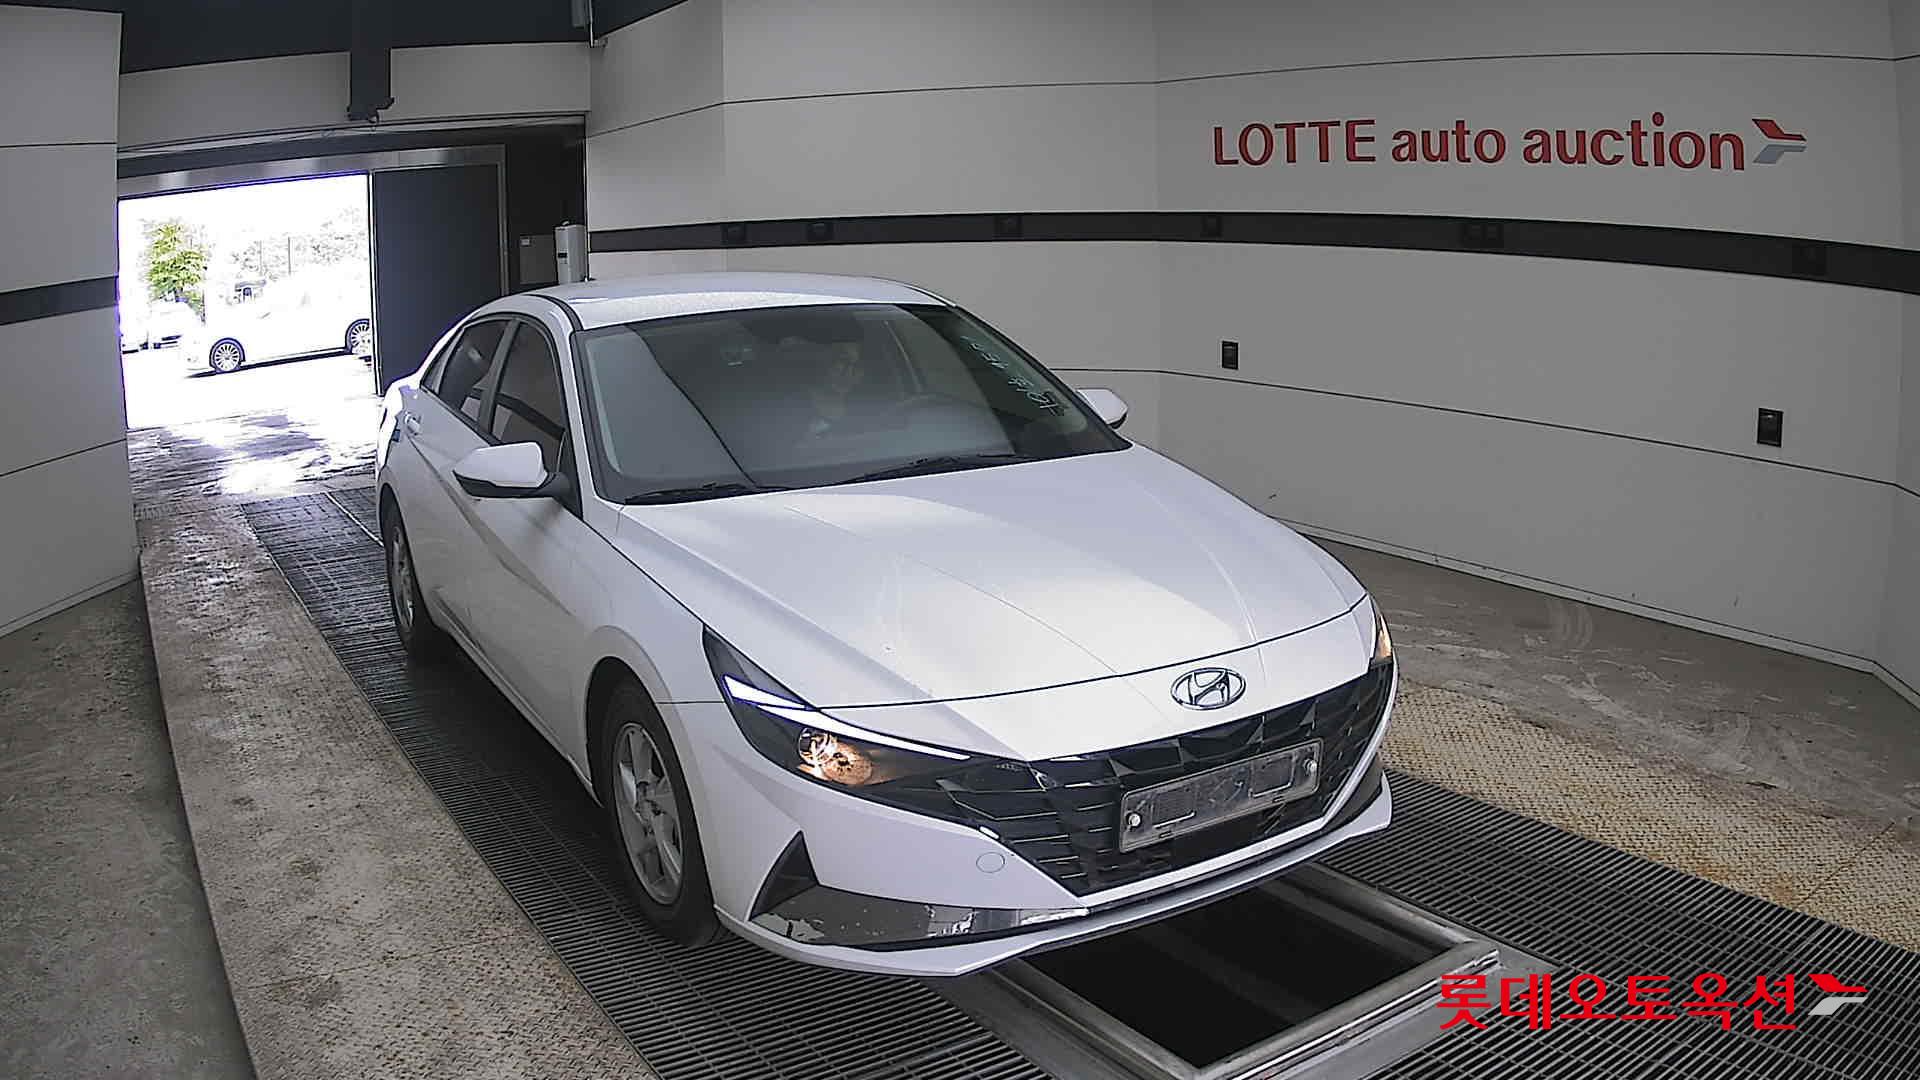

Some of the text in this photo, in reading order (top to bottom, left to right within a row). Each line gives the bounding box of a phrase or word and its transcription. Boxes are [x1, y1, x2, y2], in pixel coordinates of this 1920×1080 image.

[1213, 112, 1745, 170] LOTTE auto auction
